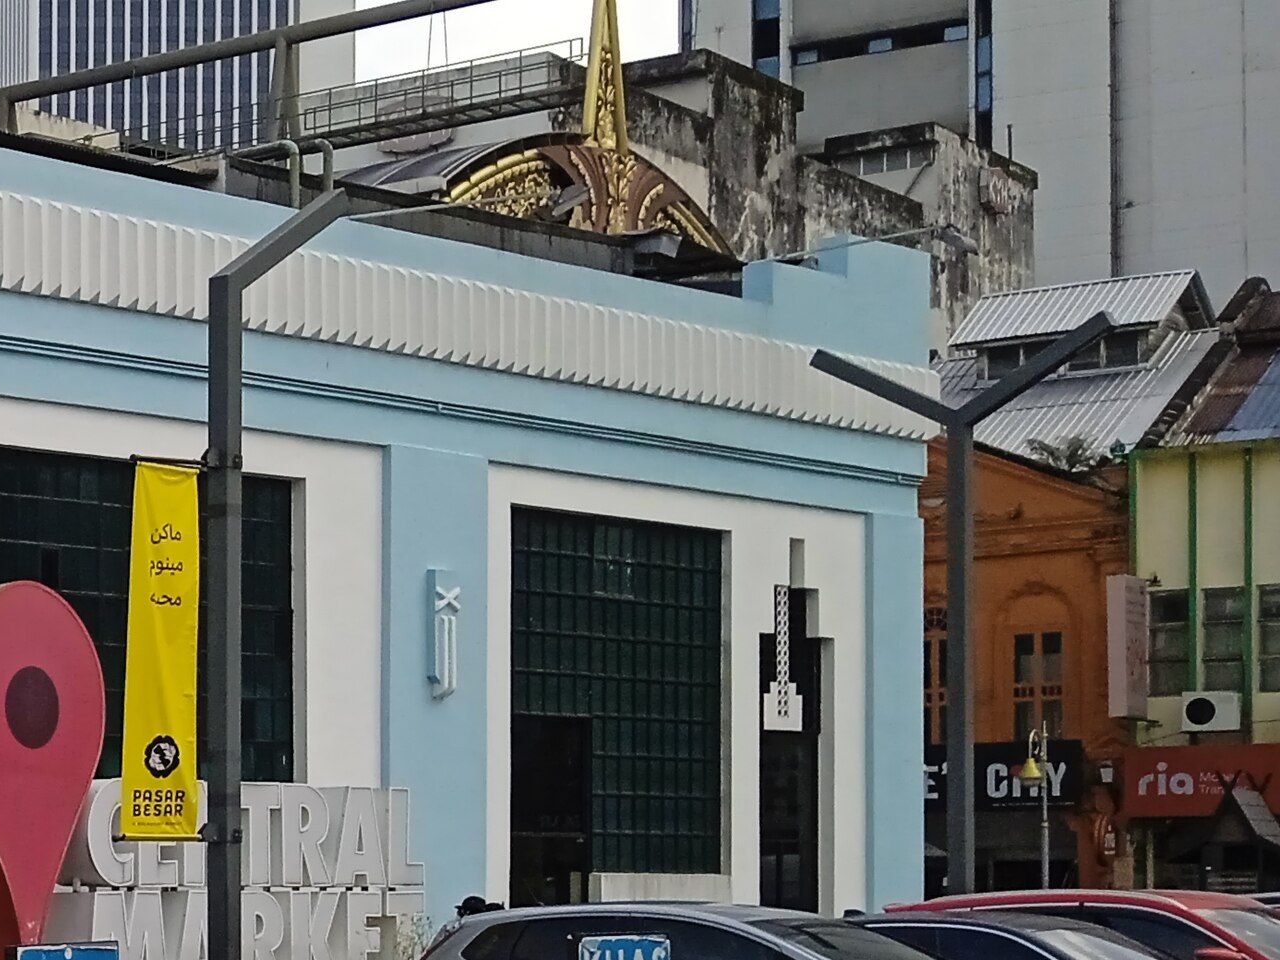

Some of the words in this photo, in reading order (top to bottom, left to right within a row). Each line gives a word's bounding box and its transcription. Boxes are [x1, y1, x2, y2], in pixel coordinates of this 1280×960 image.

[1138, 762, 1193, 795] ria
[133, 789, 185, 802] PASAR
[133, 803, 183, 816] BESAR
